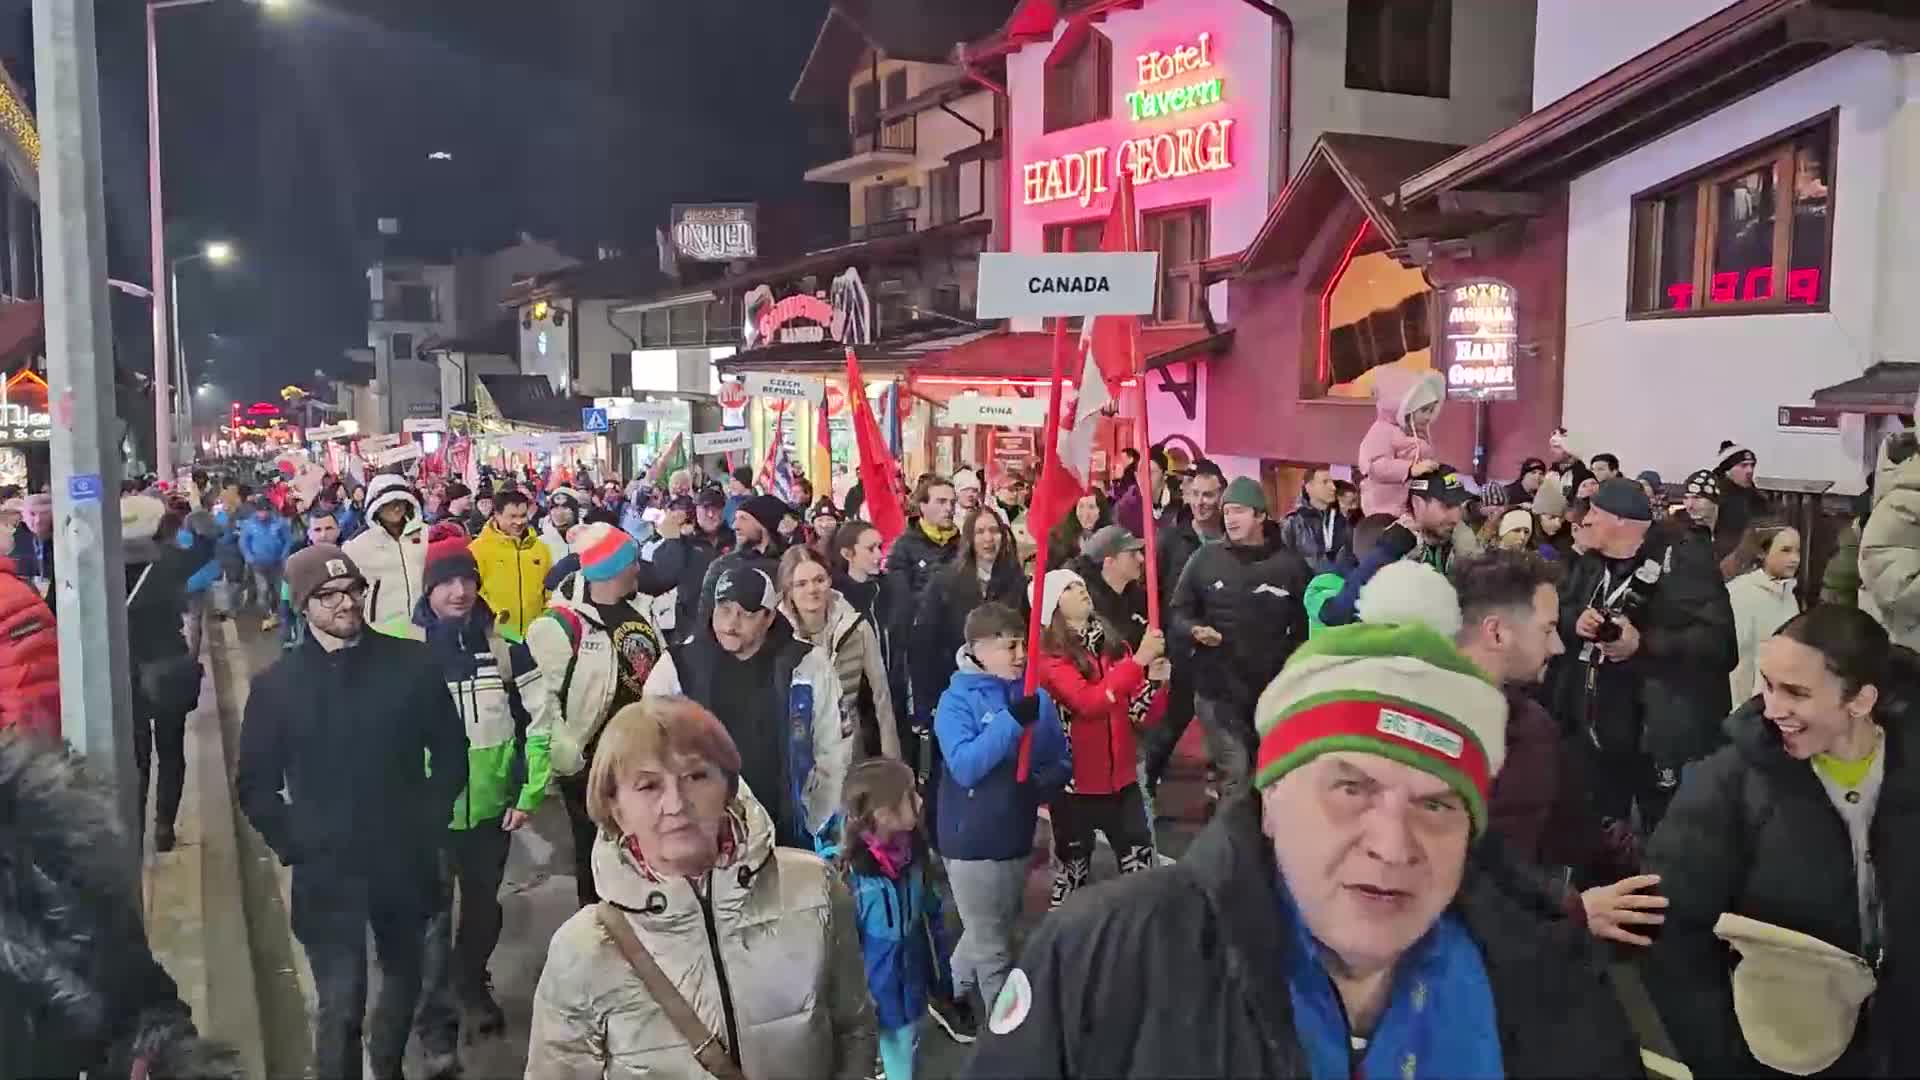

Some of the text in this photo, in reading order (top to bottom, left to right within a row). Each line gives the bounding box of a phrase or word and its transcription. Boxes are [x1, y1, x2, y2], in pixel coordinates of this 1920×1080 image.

[1136, 32, 1212, 86] Hotel
[1125, 78, 1223, 121] Tavern
[1023, 119, 1233, 208] HADJI GEORGI
[1028, 276, 1110, 294] CANADA
[1455, 283, 1509, 302] HOTEL
[762, 386, 806, 397] REPUBLIC
[770, 379, 801, 388] CZECH
[979, 406, 1013, 415] CHINA
